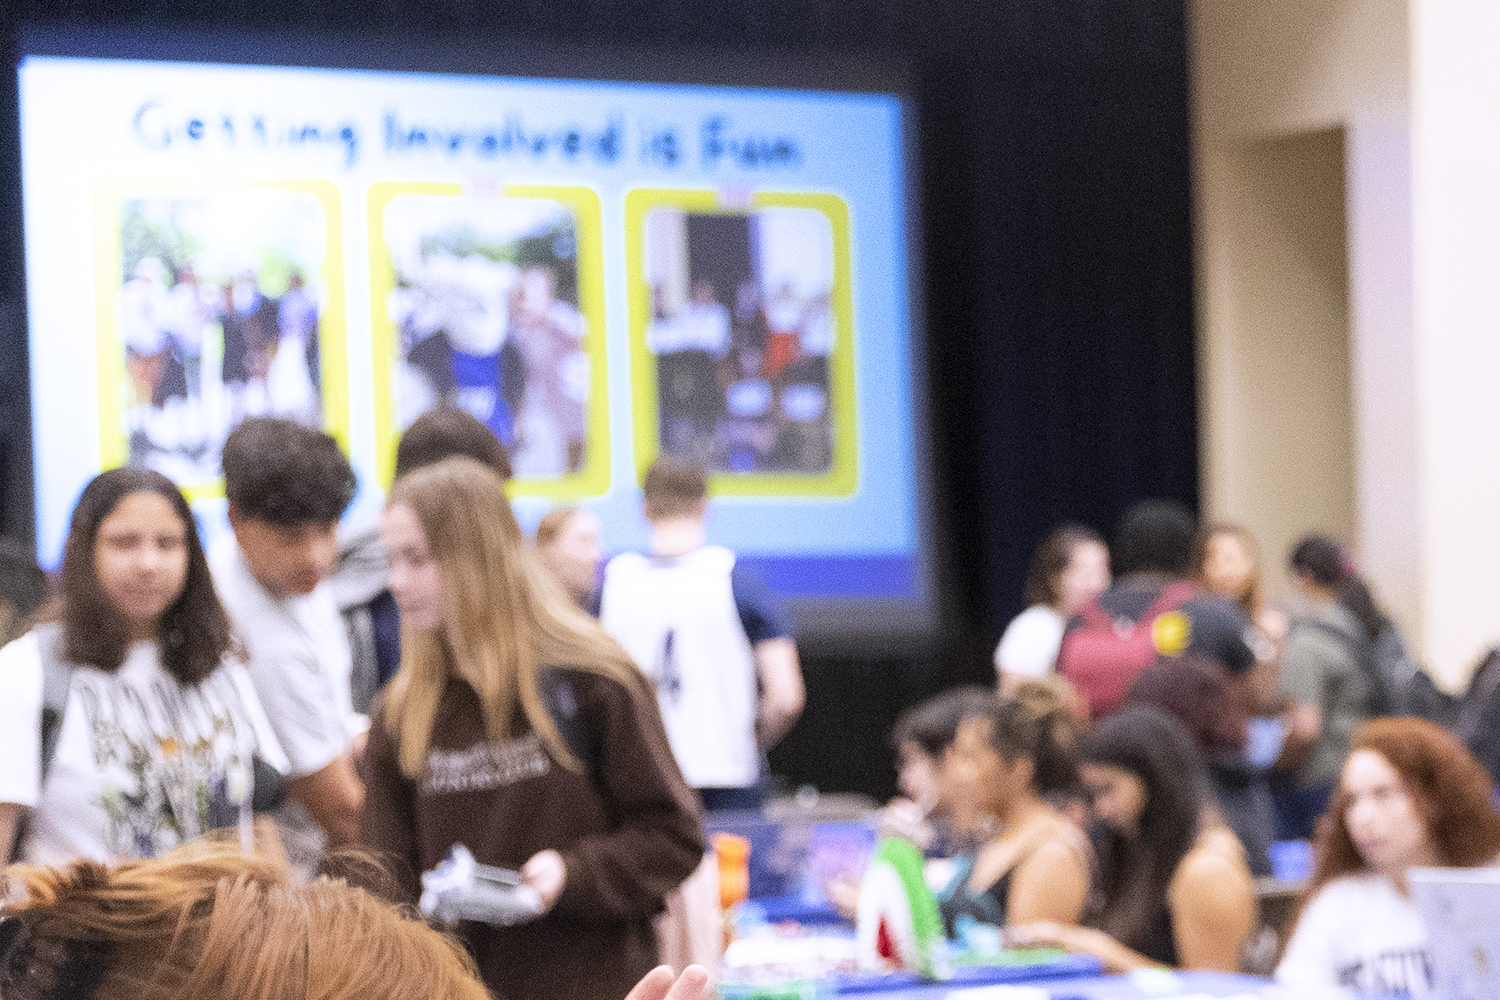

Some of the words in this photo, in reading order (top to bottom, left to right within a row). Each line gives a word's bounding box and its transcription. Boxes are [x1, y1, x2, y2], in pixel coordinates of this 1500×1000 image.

[131, 97, 362, 171] Getting
[380, 103, 624, 165] Involved
[640, 118, 682, 172] is
[702, 109, 802, 174] Fun
